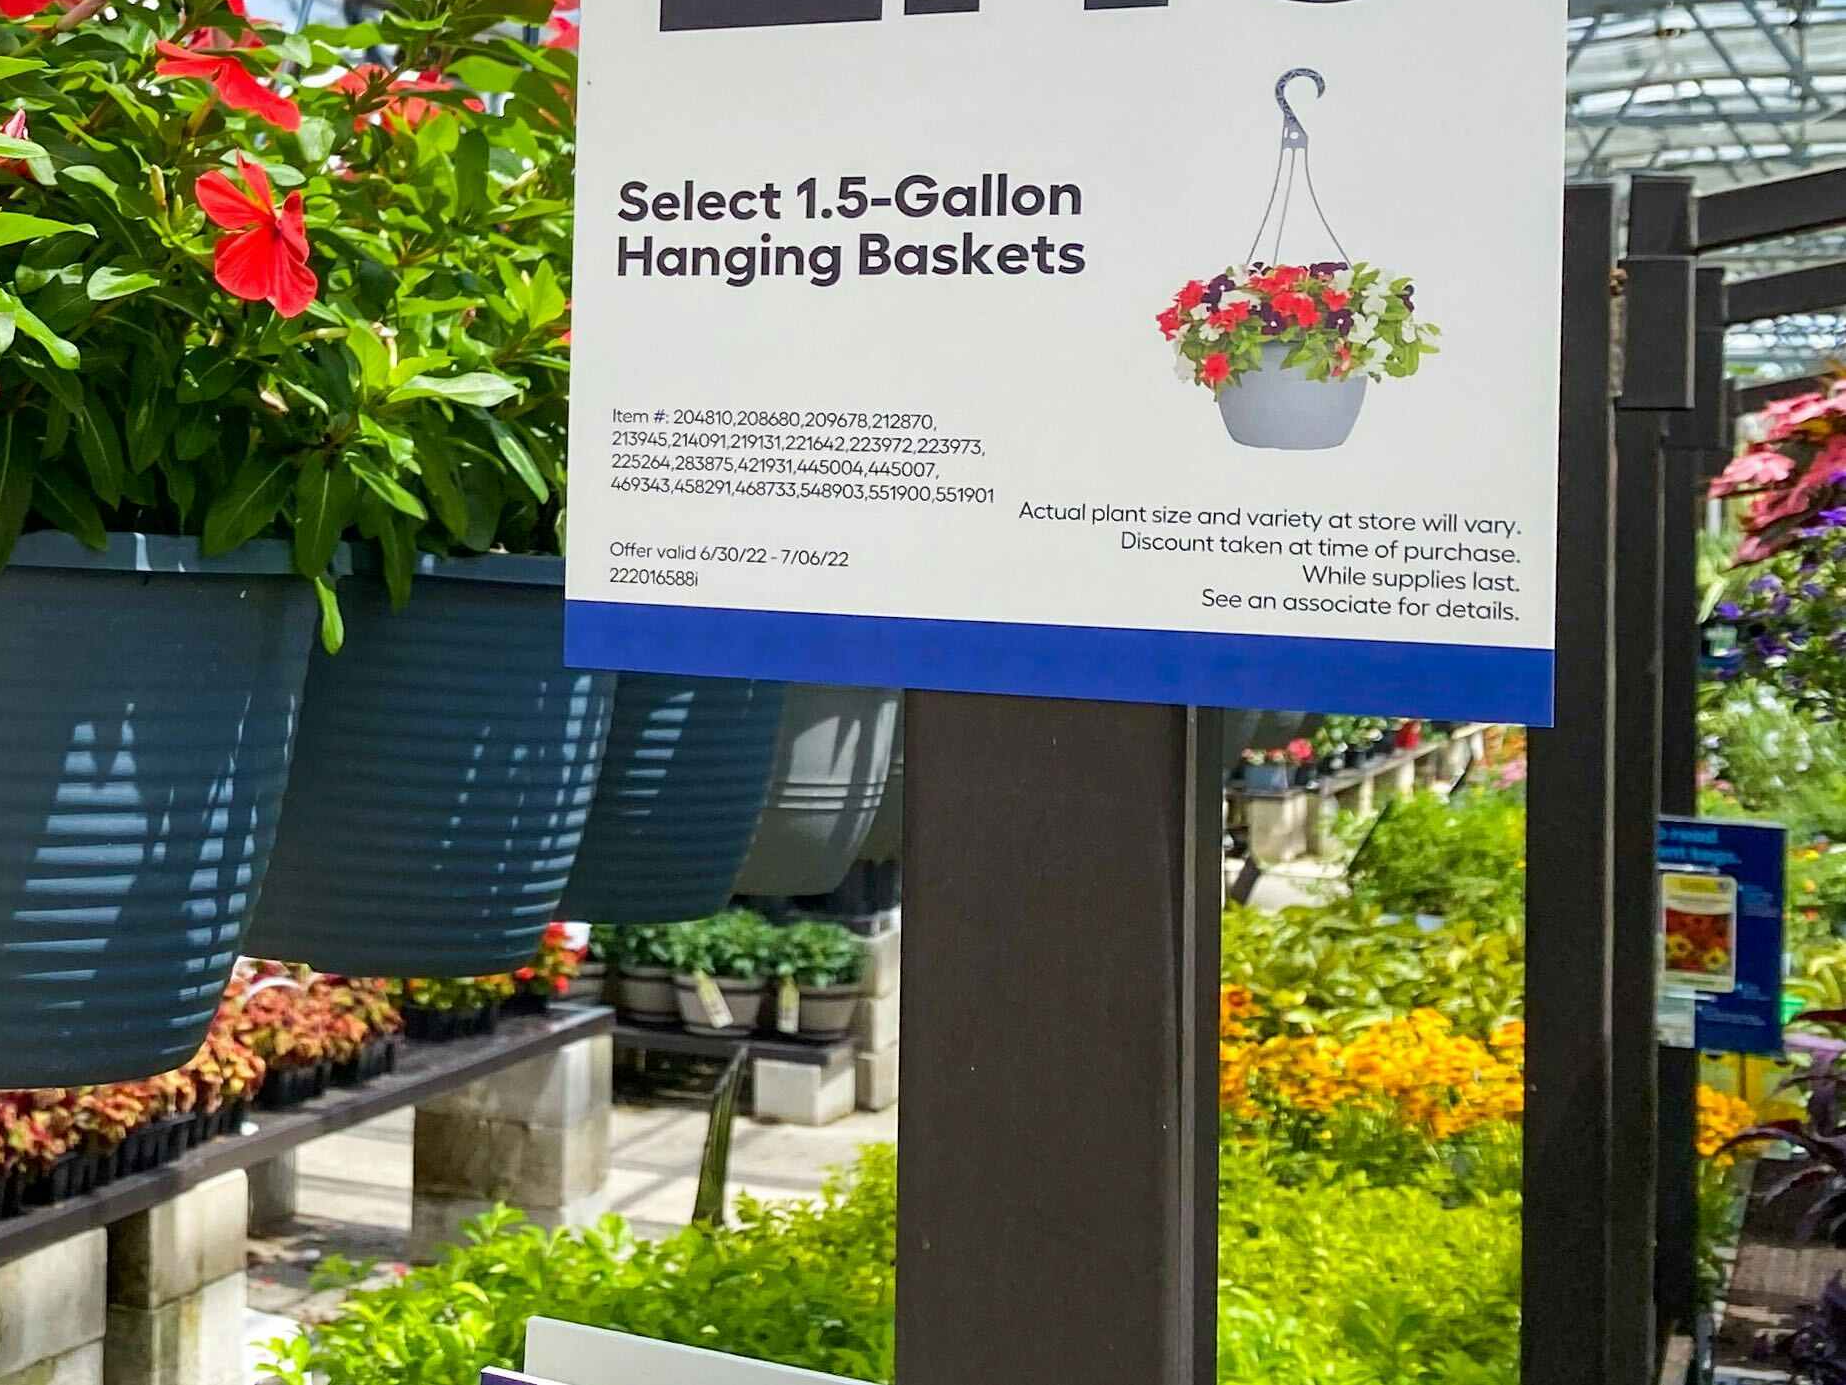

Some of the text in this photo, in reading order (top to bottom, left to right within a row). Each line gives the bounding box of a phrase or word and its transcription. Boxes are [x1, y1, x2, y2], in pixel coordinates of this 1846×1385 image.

[617, 172, 1082, 222] Select 1.5-Gallon
[617, 231, 1086, 288] Hanging Baskets
[611, 407, 650, 424] Item
[653, 408, 670, 425] #:
[1018, 501, 1522, 539] Actual plant size and variety at store will vary.
[609, 541, 654, 559] Offer
[657, 544, 696, 561] valid
[699, 546, 768, 564] 6/30/22
[781, 549, 850, 568] 7/06/22
[1120, 531, 1522, 564] Discount taken at time of purchase.
[1301, 564, 1521, 593] While supplies last.
[1201, 588, 1521, 622] See an associate for details.
